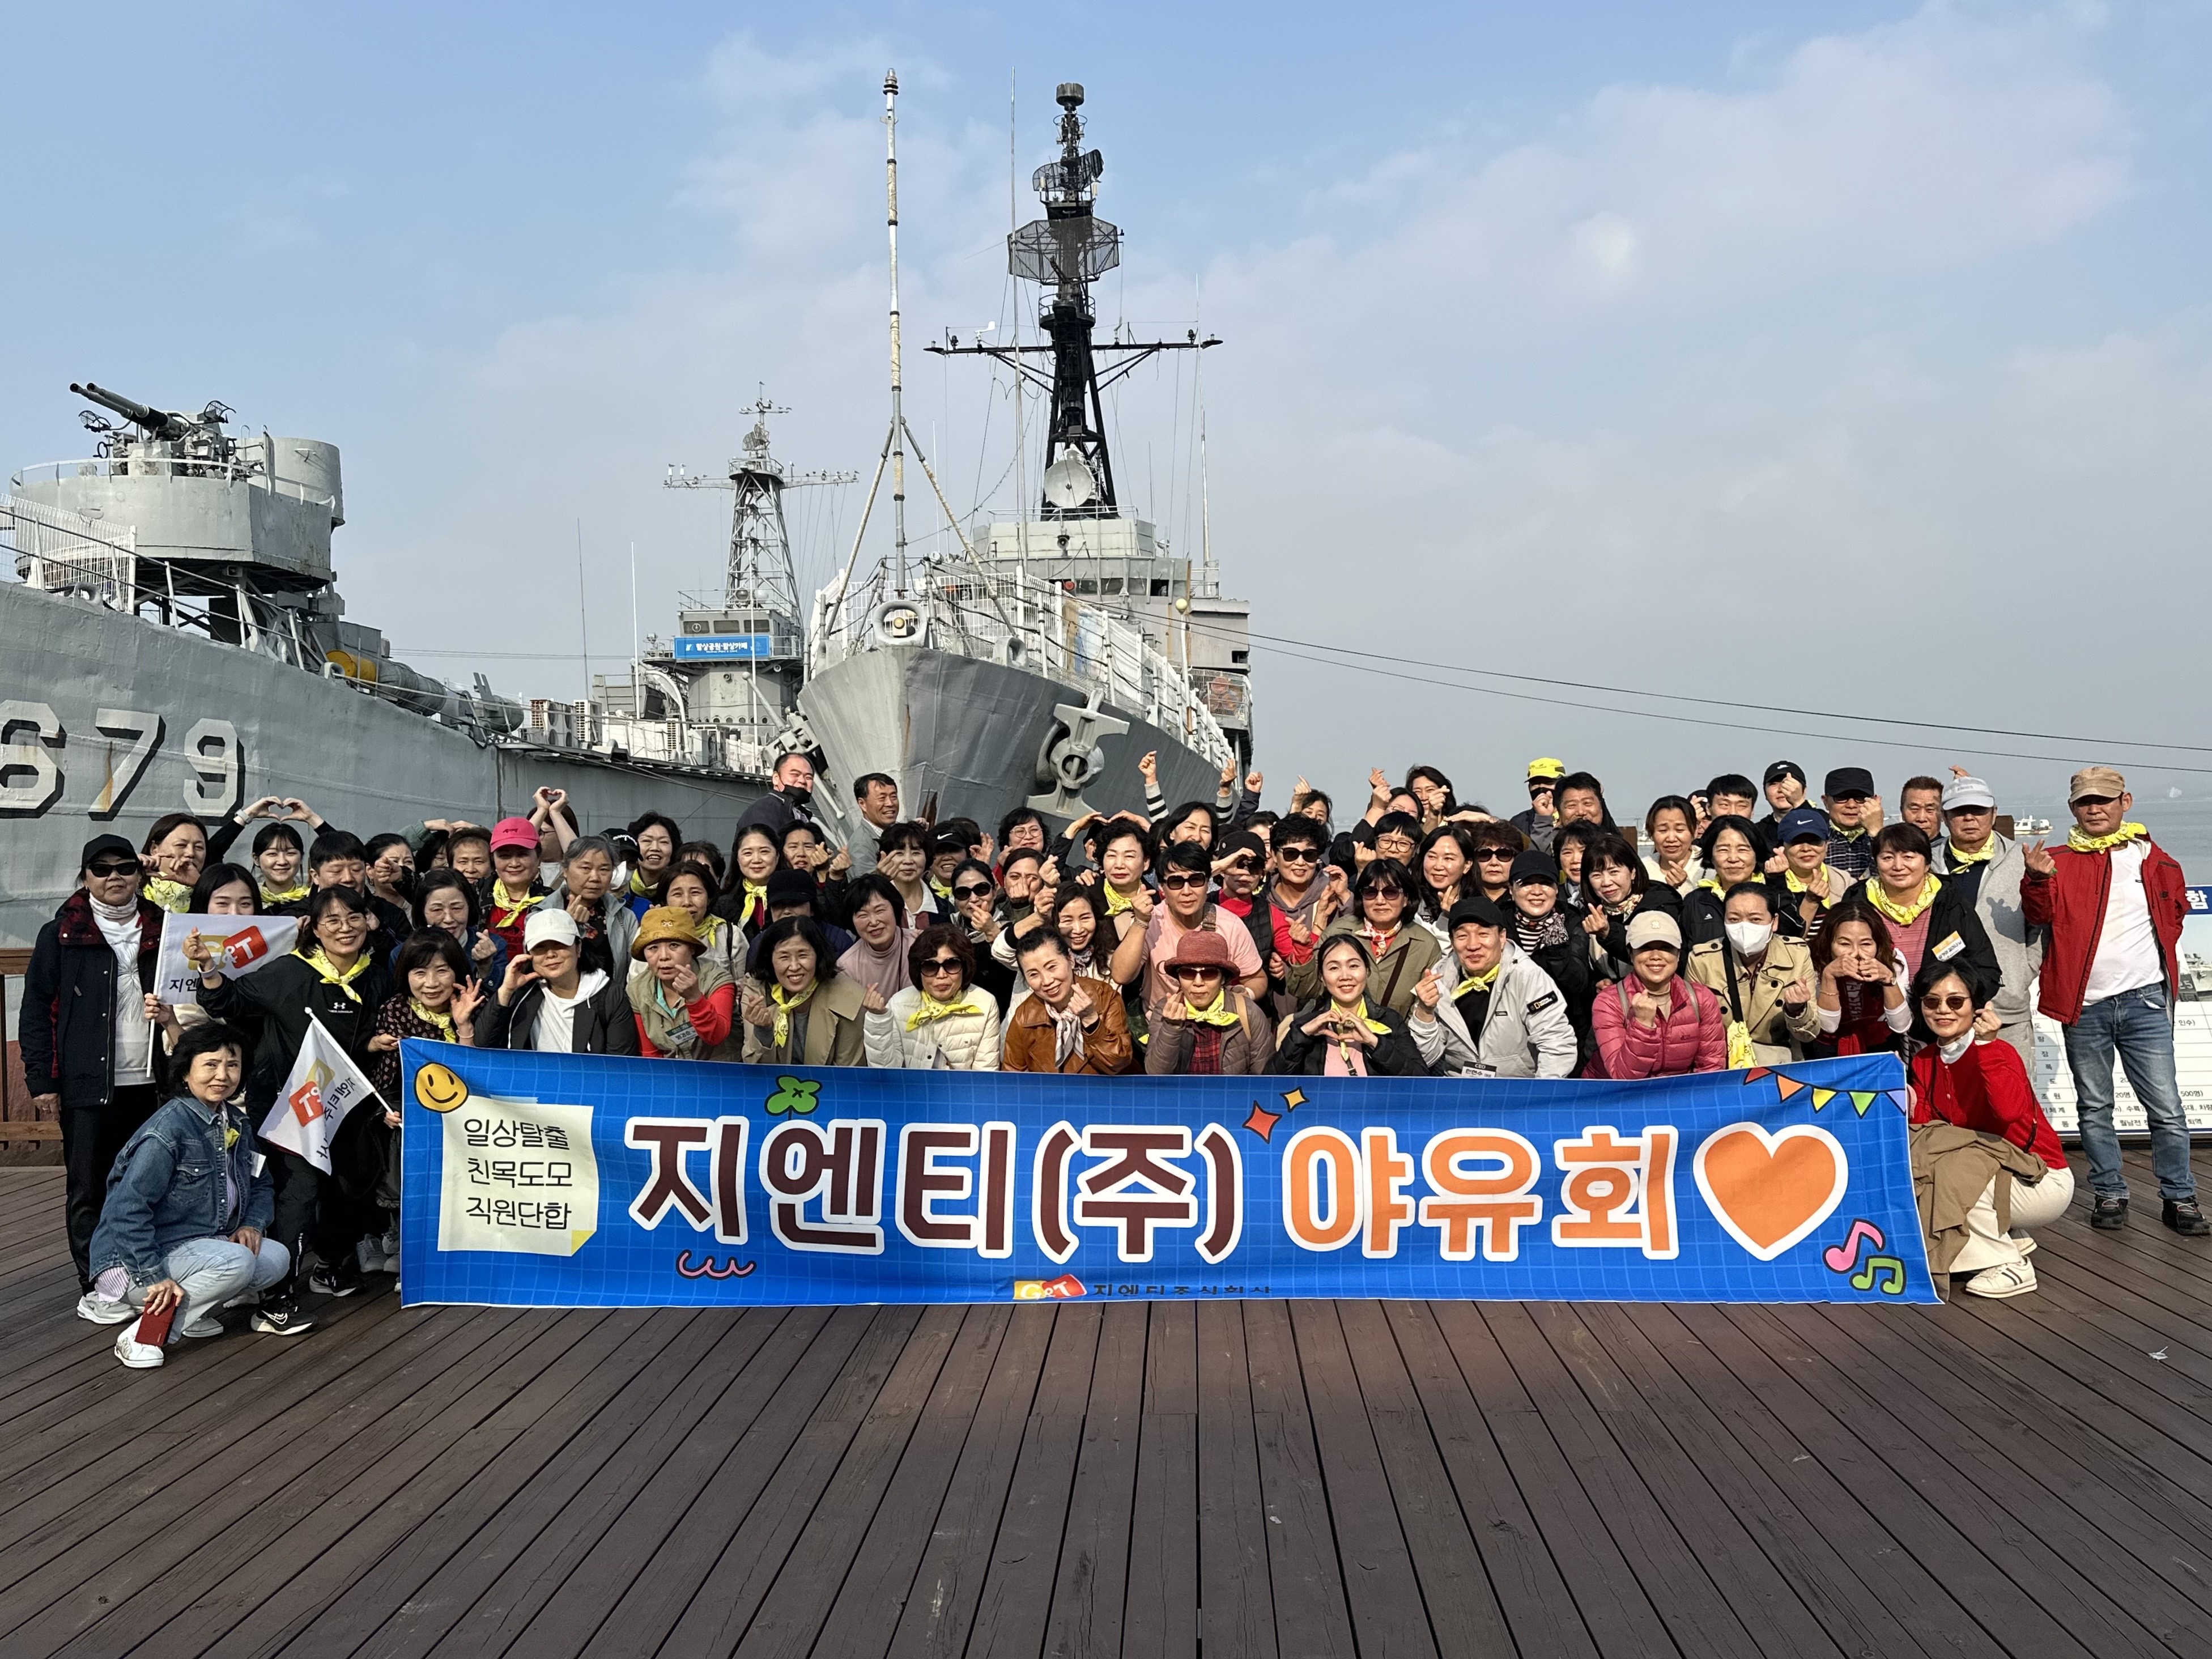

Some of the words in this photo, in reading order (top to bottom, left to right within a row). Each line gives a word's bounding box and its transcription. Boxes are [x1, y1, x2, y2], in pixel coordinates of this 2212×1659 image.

[0, 699, 245, 825] 679
[2185, 890, 2209, 910] 함
[463, 1117, 571, 1151] 일상탈출
[466, 1156, 573, 1189] 친목도모
[624, 1116, 1243, 1265] 지엔티(주)
[1282, 1125, 1679, 1262] 야유회
[466, 1196, 572, 1230] 직원단합
